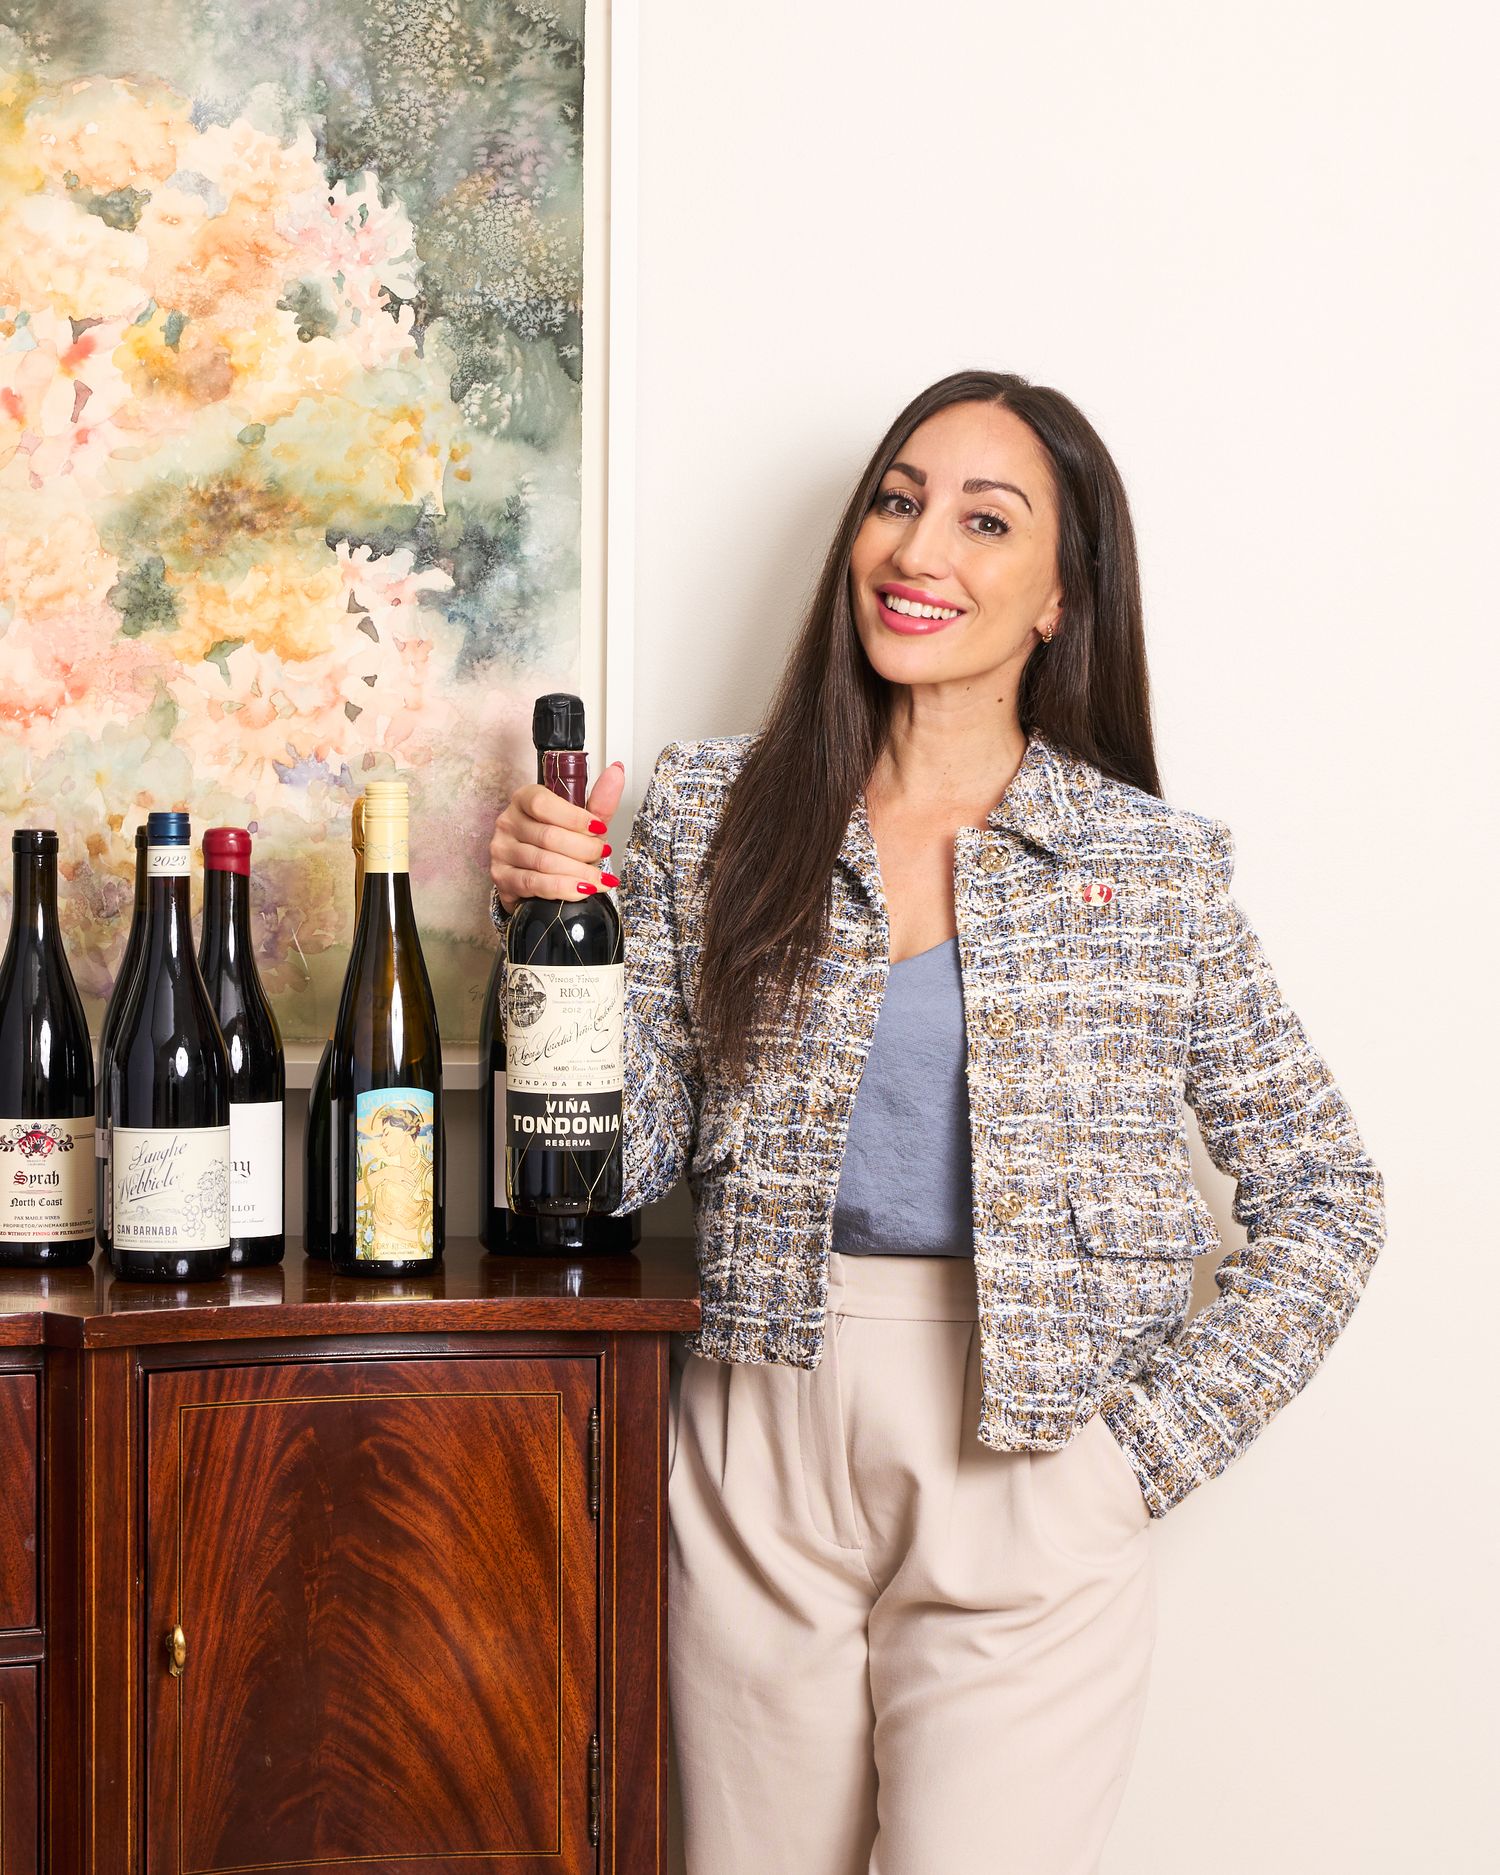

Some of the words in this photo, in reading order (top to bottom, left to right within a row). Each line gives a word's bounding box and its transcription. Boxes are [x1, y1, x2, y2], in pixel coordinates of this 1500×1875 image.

[153, 855, 187, 867] 2023
[560, 988, 591, 999] RIOJA
[513, 1078, 567, 1087] FUNDADA
[601, 1078, 620, 1086] 1877
[545, 1097, 591, 1114] VIÑA
[513, 1114, 620, 1135] TONDONIA
[545, 1139, 591, 1147] RESERVA
[129, 1136, 188, 1172] Langhe
[13, 1170, 60, 1188] Syrah
[10, 1197, 36, 1207] North
[38, 1197, 63, 1207] Coast
[116, 1224, 131, 1235] SAN
[133, 1226, 178, 1236] BARNABA
